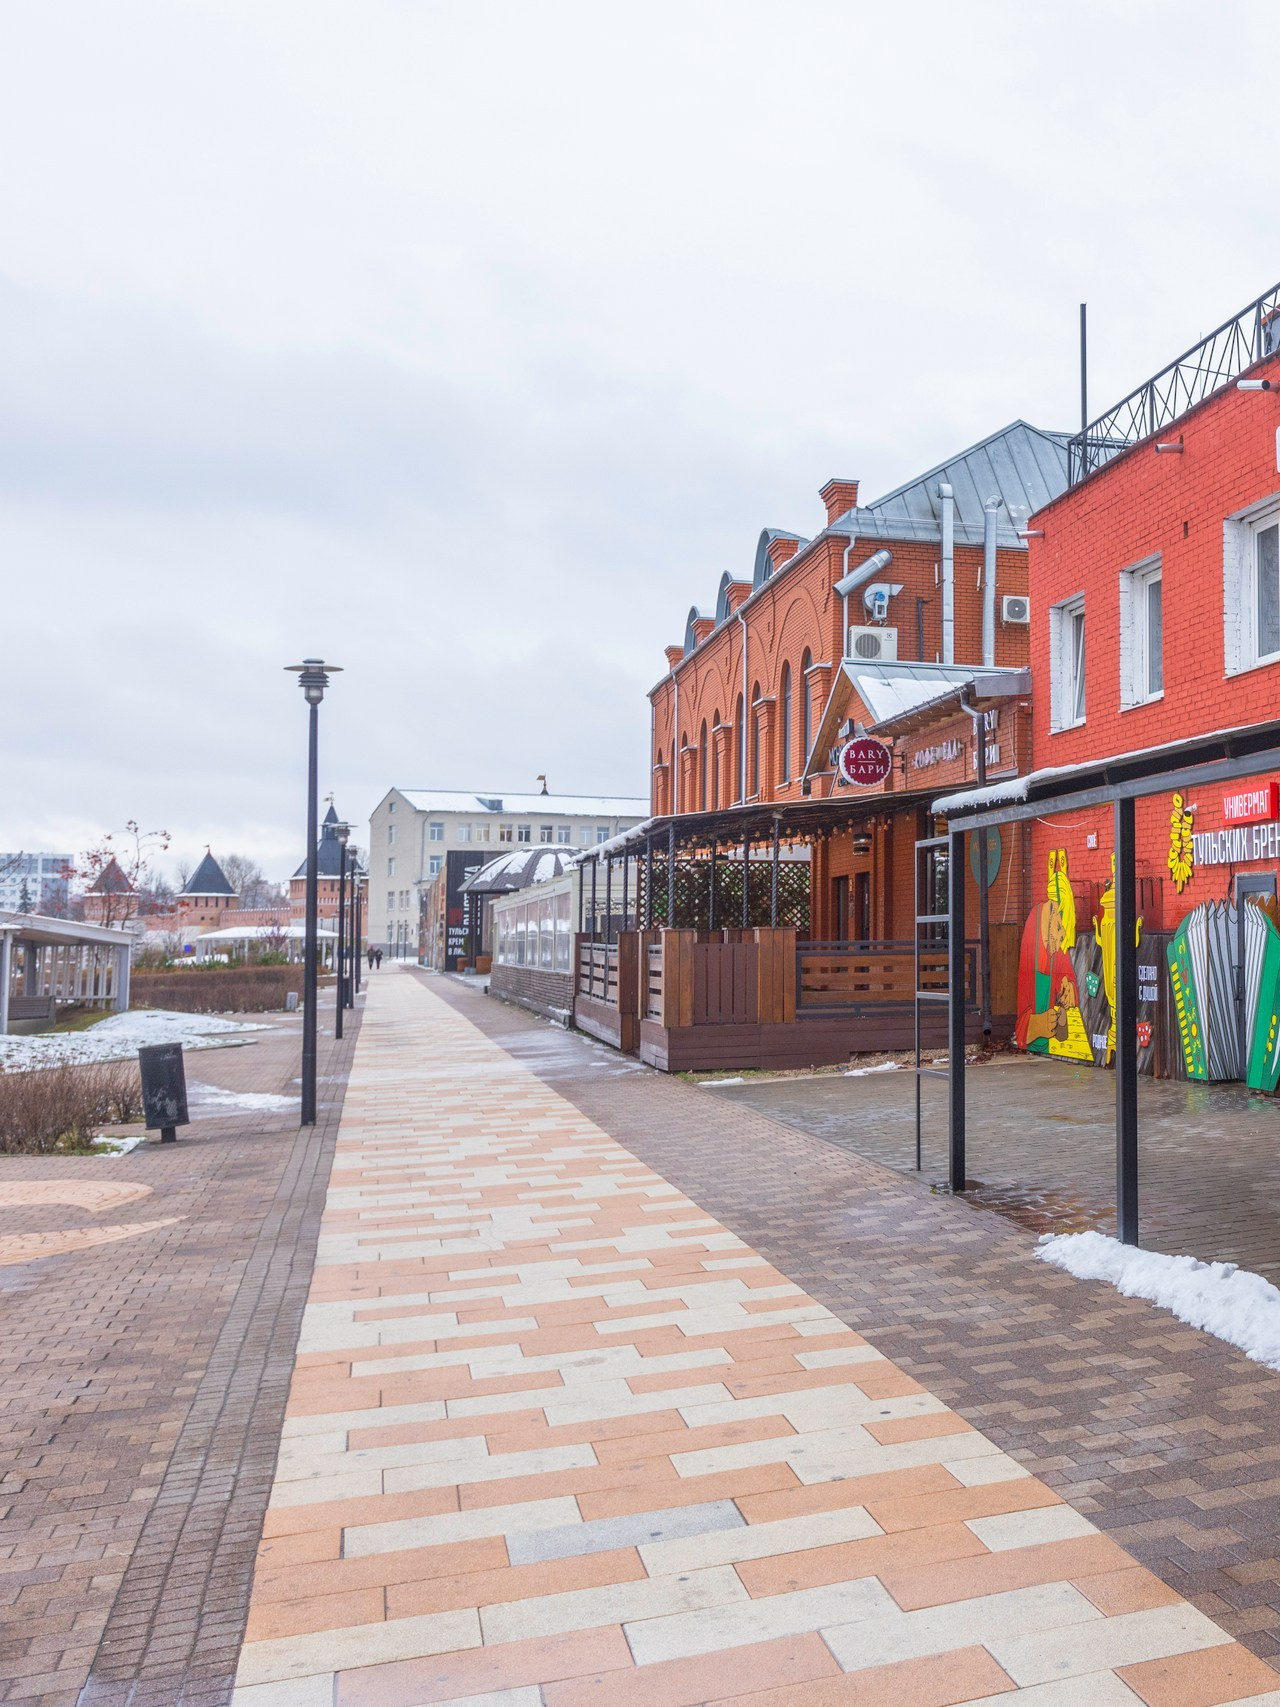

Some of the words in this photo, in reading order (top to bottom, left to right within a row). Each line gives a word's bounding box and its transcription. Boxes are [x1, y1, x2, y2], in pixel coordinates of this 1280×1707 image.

[972, 709, 999, 735] BRY
[849, 749, 884, 759] BARY
[972, 744, 1000, 770] БРИ
[849, 765, 885, 774] БАРИ
[1223, 789, 1270, 820] УНИВЕРМАГ
[1191, 827, 1249, 866] ТУЛЬСКИХ
[448, 937, 464, 946] КРЕМ
[1138, 965, 1157, 982] СДЕЛАНО
